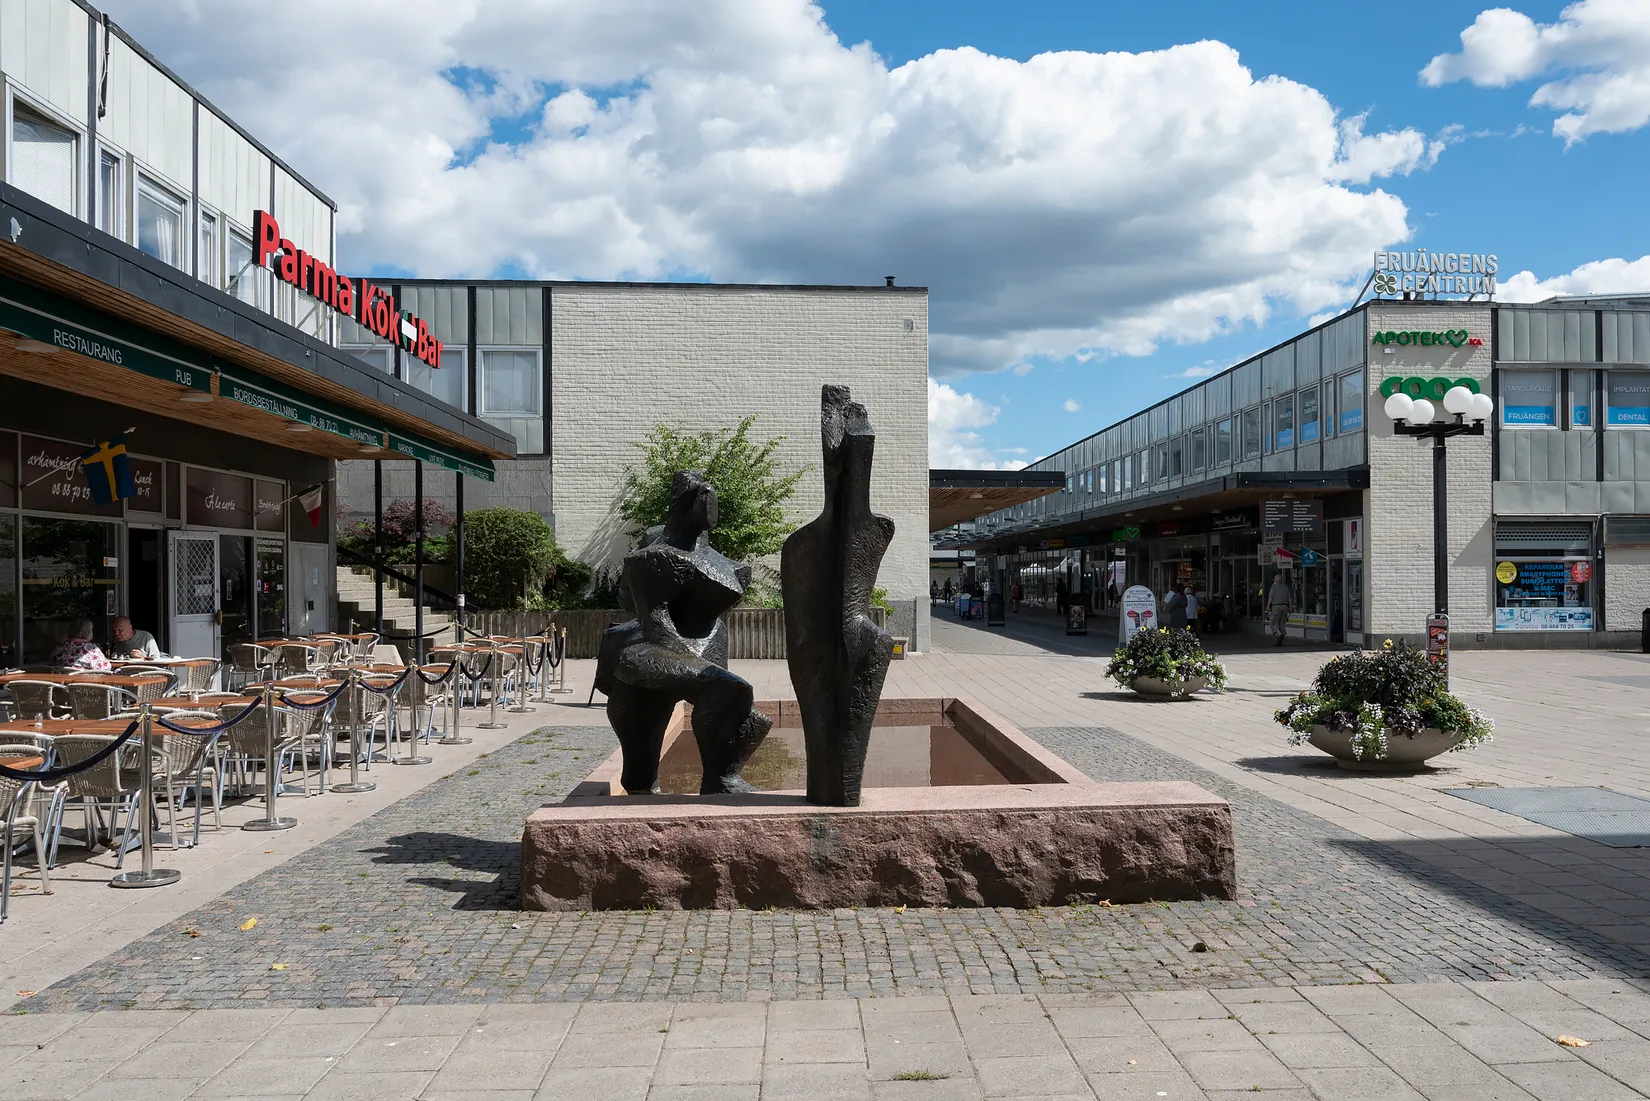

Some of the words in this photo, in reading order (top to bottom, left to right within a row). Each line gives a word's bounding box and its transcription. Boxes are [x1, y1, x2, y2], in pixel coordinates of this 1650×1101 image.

[1373, 248, 1498, 274] FRUÄNGENS
[252, 209, 353, 316] Parma
[356, 278, 400, 345] Kök
[413, 317, 443, 369] Bar
[1401, 274, 1497, 294] CENTRUM
[53, 328, 122, 364] RESTAURANG
[1372, 330, 1446, 346] APOTEK
[1469, 338, 1483, 346] ICA
[175, 369, 192, 386] PUB
[233, 387, 298, 420] BORDSBESTÄLLNING
[1508, 411, 1549, 420] FRUÄNGEN
[1618, 413, 1647, 421] DENTAL
